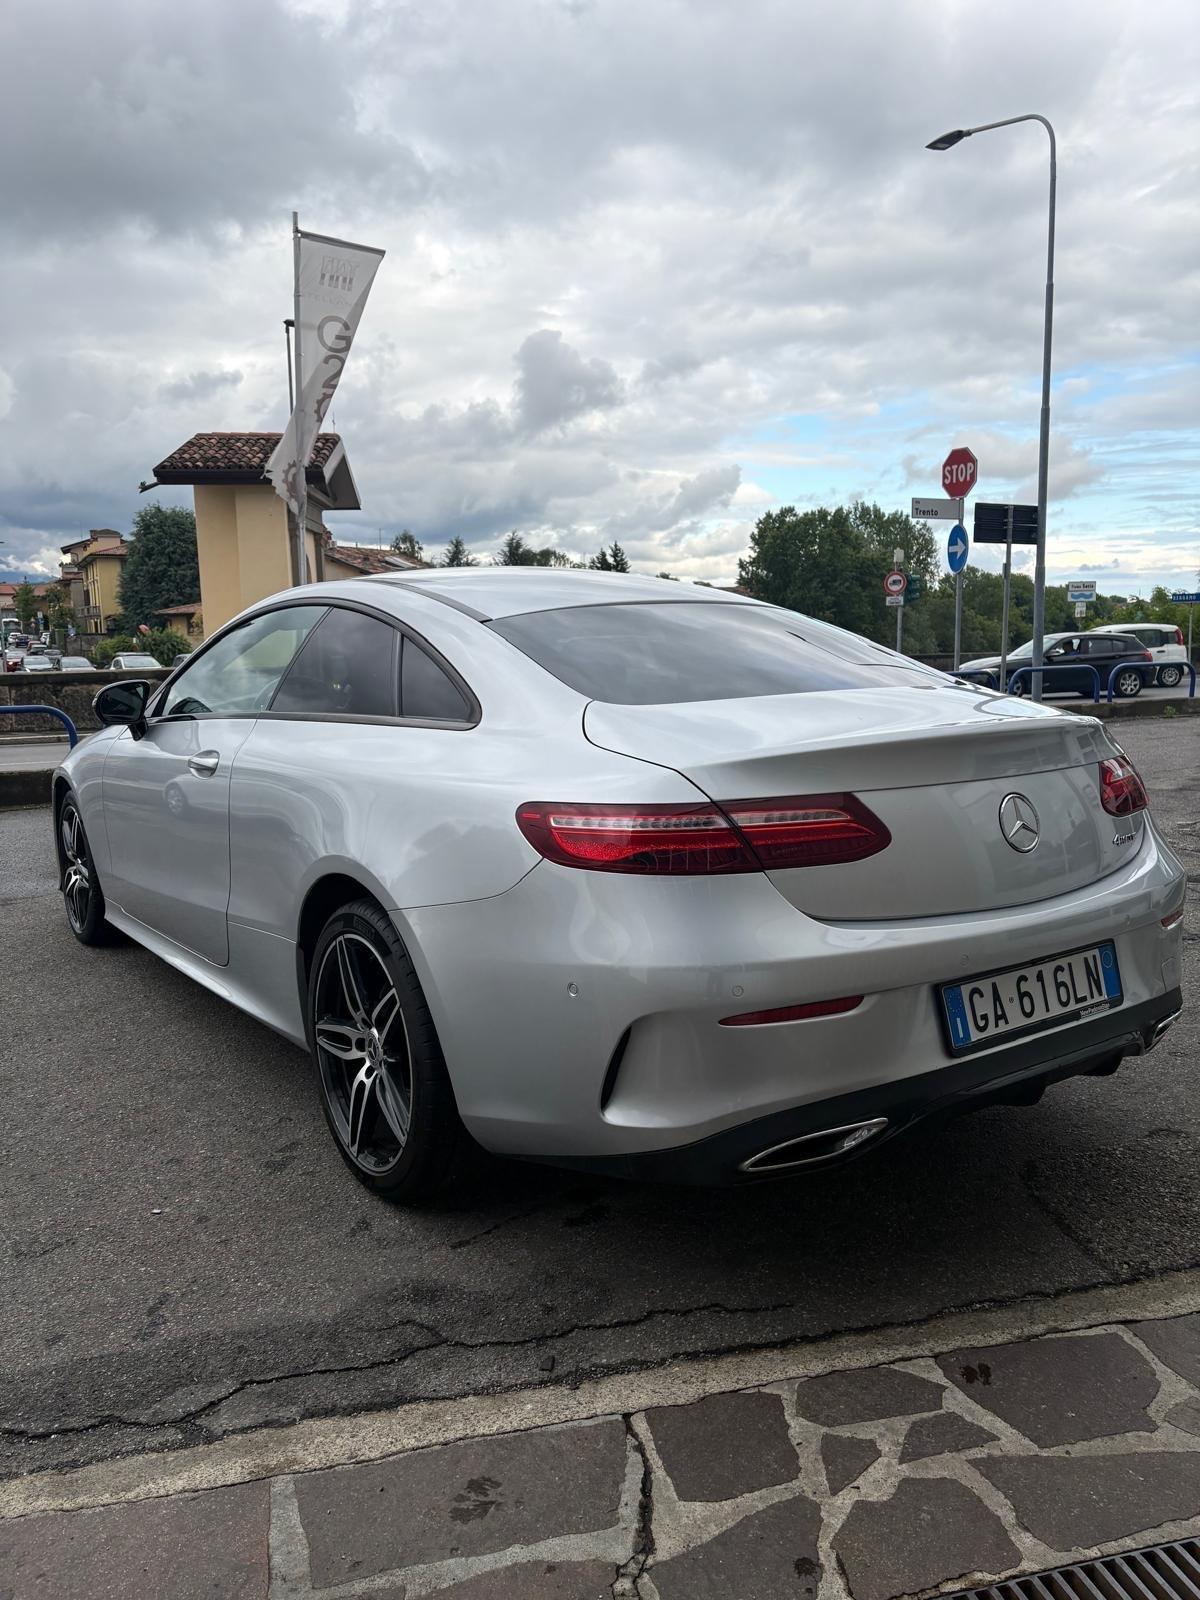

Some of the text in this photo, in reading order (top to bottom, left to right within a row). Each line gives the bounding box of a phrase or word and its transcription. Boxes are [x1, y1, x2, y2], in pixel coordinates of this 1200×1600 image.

[943, 462, 975, 485] STOP
[915, 507, 939, 516] Trento
[968, 981, 1010, 1033] GA
